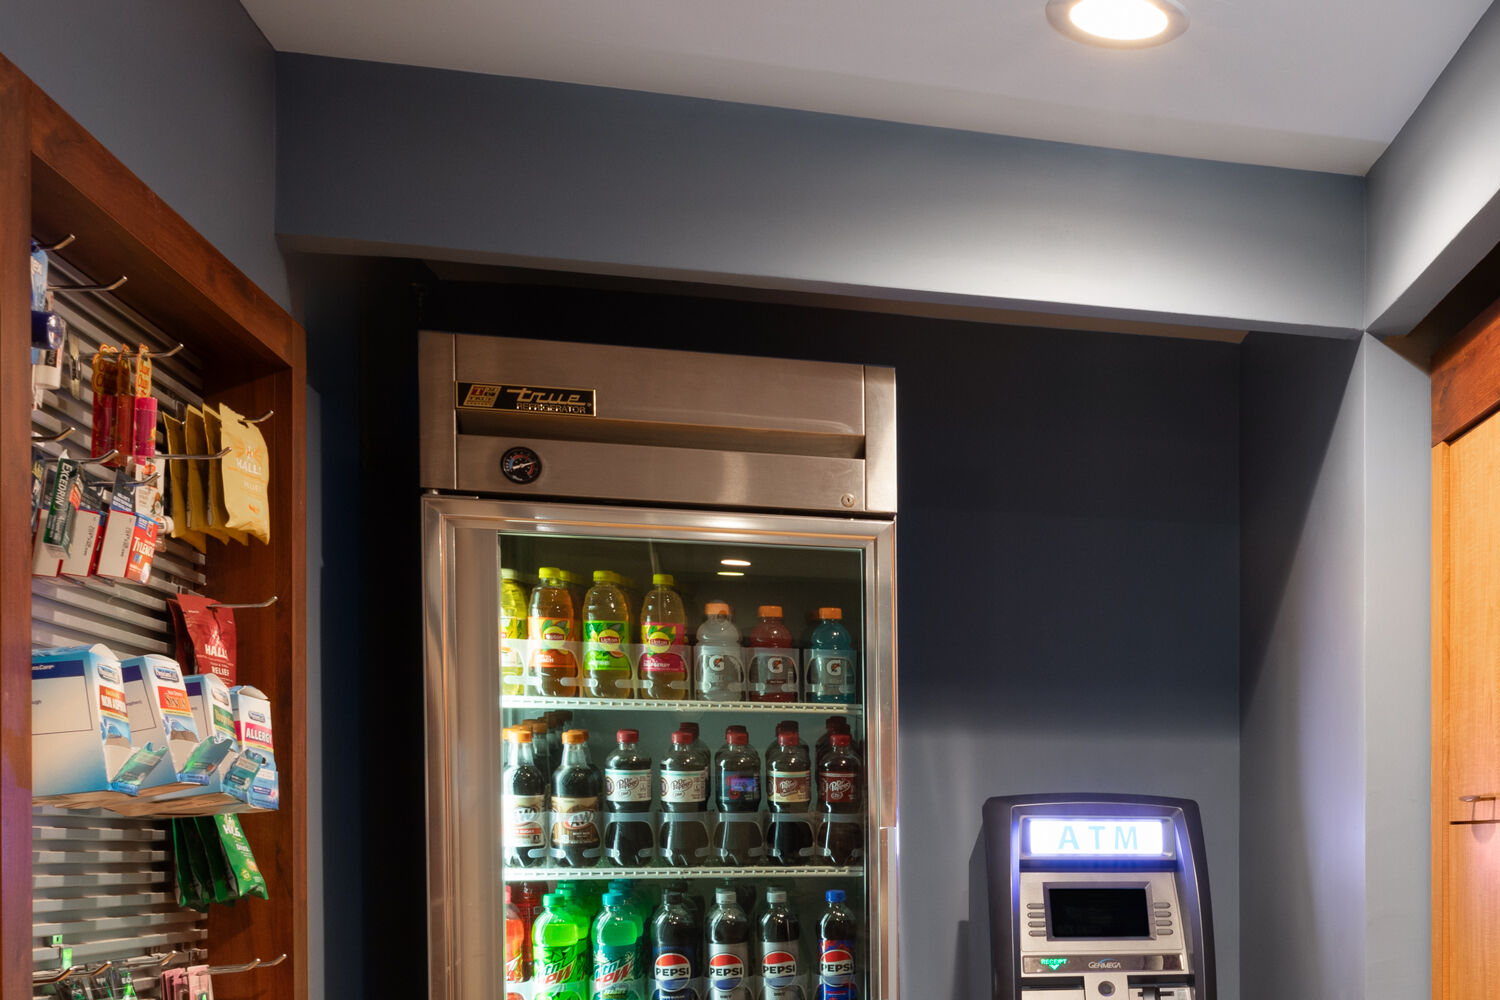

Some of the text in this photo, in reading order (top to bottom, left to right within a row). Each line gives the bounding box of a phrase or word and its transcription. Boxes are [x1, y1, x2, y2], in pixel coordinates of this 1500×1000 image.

[516, 402, 586, 414] REFRIGERATOR
[55, 462, 74, 507] EXCEDRIN
[600, 636, 620, 644] Lipton
[650, 639, 668, 647] Lipton
[246, 728, 272, 745] ALLERGY
[1058, 825, 1139, 851] ATM
[655, 966, 690, 977] PEPSI
[709, 966, 743, 976] PEPSI
[762, 964, 796, 974] PEPSI
[820, 962, 853, 973] PEPSI
